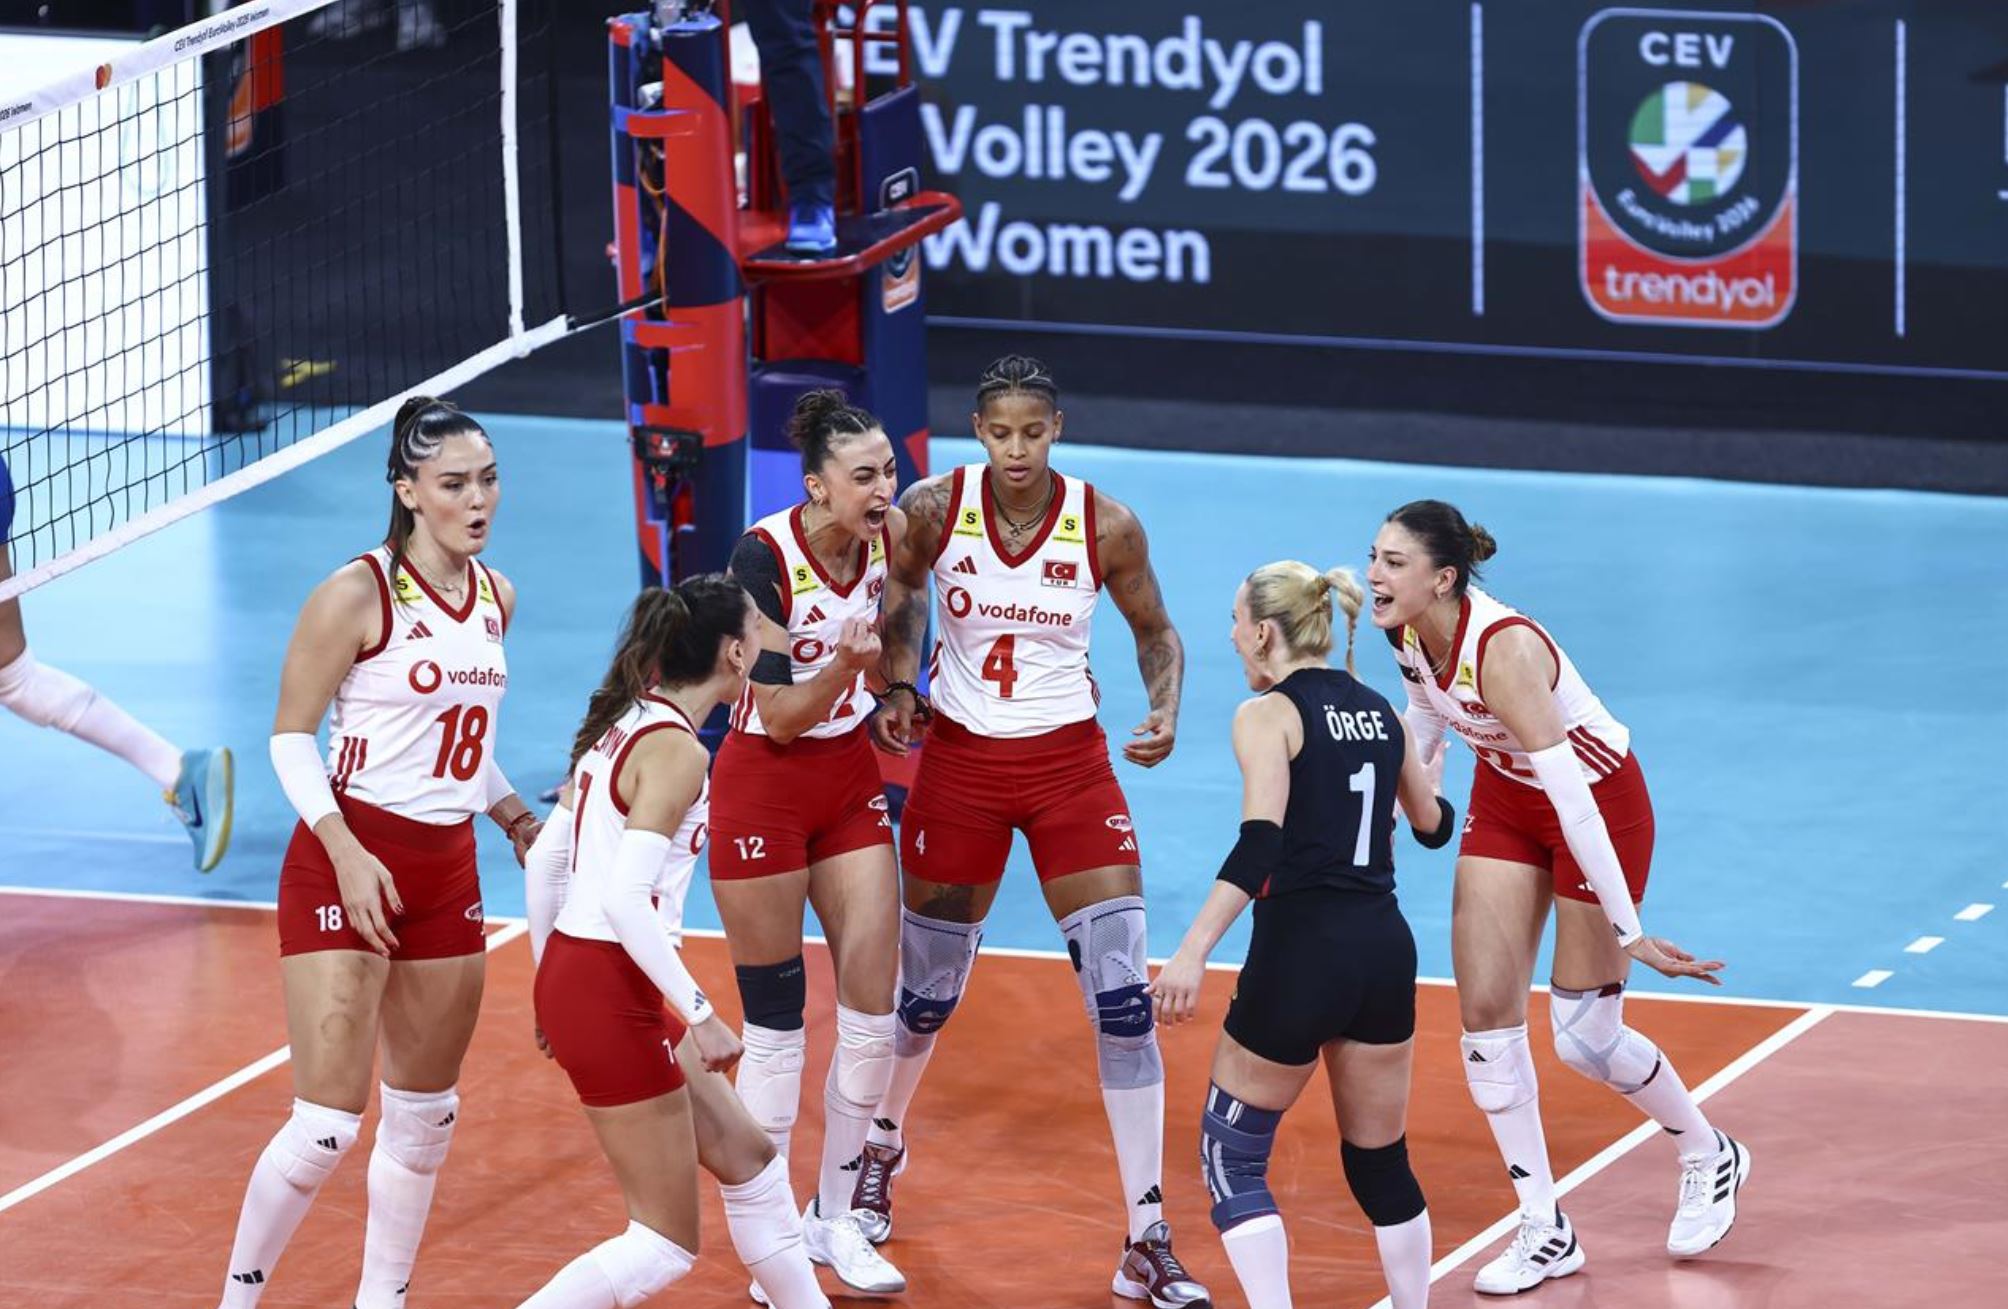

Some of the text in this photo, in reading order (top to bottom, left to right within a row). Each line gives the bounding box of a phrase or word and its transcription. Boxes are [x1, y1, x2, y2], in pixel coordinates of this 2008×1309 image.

[977, 9, 1323, 110] Trendyol
[1639, 31, 1735, 69] CEV
[1185, 116, 1378, 195] 2026
[921, 201, 1211, 283] Women
[1604, 264, 1775, 313] trendyol
[966, 511, 977, 525] S
[1065, 518, 1076, 532] S
[796, 568, 807, 581] S
[978, 603, 1073, 627] vodafone
[981, 633, 1019, 698] 4
[1322, 704, 1390, 742] ÖRGE
[432, 703, 489, 782] 18
[1348, 761, 1377, 867] 1
[734, 835, 767, 861] 12
[914, 829, 926, 856] 4
[314, 904, 344, 932] 18
